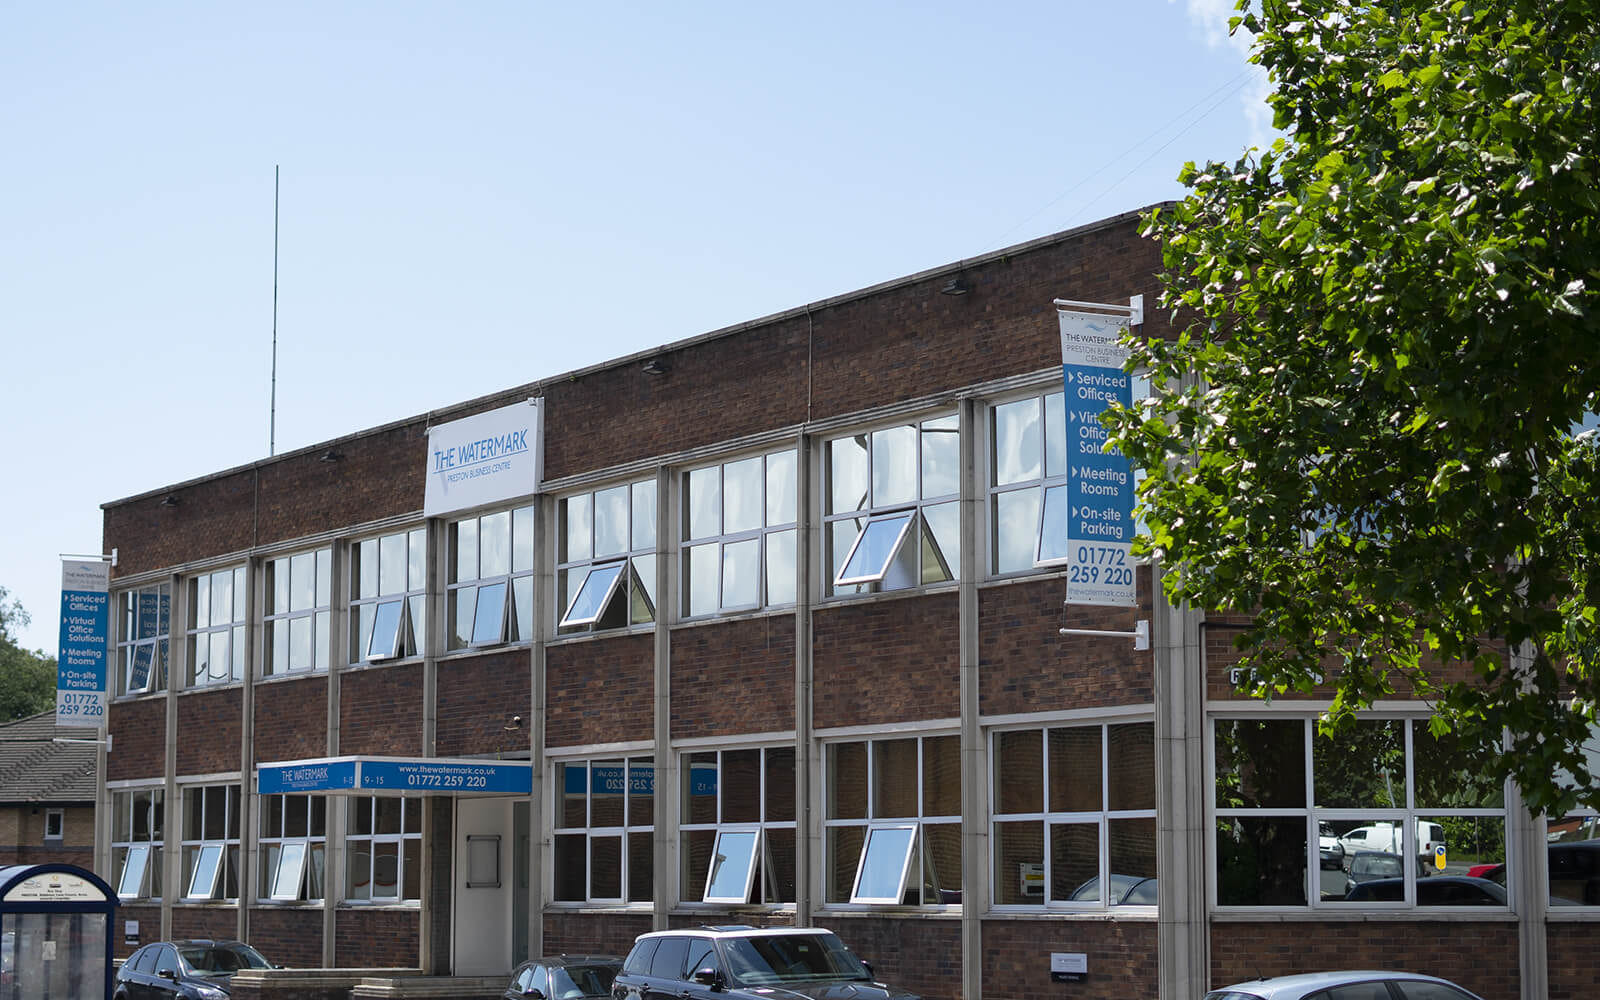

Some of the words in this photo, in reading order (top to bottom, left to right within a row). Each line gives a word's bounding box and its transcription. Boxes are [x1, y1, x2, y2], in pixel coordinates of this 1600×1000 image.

[1066, 333, 1080, 342] THE
[1082, 335, 1119, 345] WATERM
[1066, 345, 1096, 354] PRESTON
[1077, 371, 1127, 388] Serviced
[1077, 386, 1118, 401] Offices
[1078, 410, 1103, 424] Virt
[434, 447, 456, 470] THE
[458, 428, 528, 465] WATERMARK
[1080, 466, 1127, 485] Meeting
[1081, 481, 1119, 496] Rooms
[1080, 506, 1121, 520] On-site
[1081, 521, 1123, 539] Parking
[1078, 546, 1126, 566] 01772
[1070, 565, 1099, 583] 259
[1104, 567, 1133, 586] 220
[69, 594, 106, 604] Serviced
[69, 602, 98, 612] Offices
[69, 616, 96, 625] Virtual
[68, 625, 94, 634] Office
[68, 634, 105, 643] Solutions
[67, 647, 102, 659] Meeting
[67, 657, 96, 665] Rooms
[66, 670, 97, 680] On-site
[66, 679, 98, 690] Parking
[64, 693, 98, 705] 01772
[60, 704, 79, 715] 259
[83, 705, 104, 716] 220
[281, 770, 293, 782] THE
[294, 767, 329, 781] WATERMARK
[398, 765, 496, 776] www.thewatermark.co.uk
[408, 774, 441, 786] 01772
[444, 775, 463, 787] 259
[466, 776, 487, 788] 220
